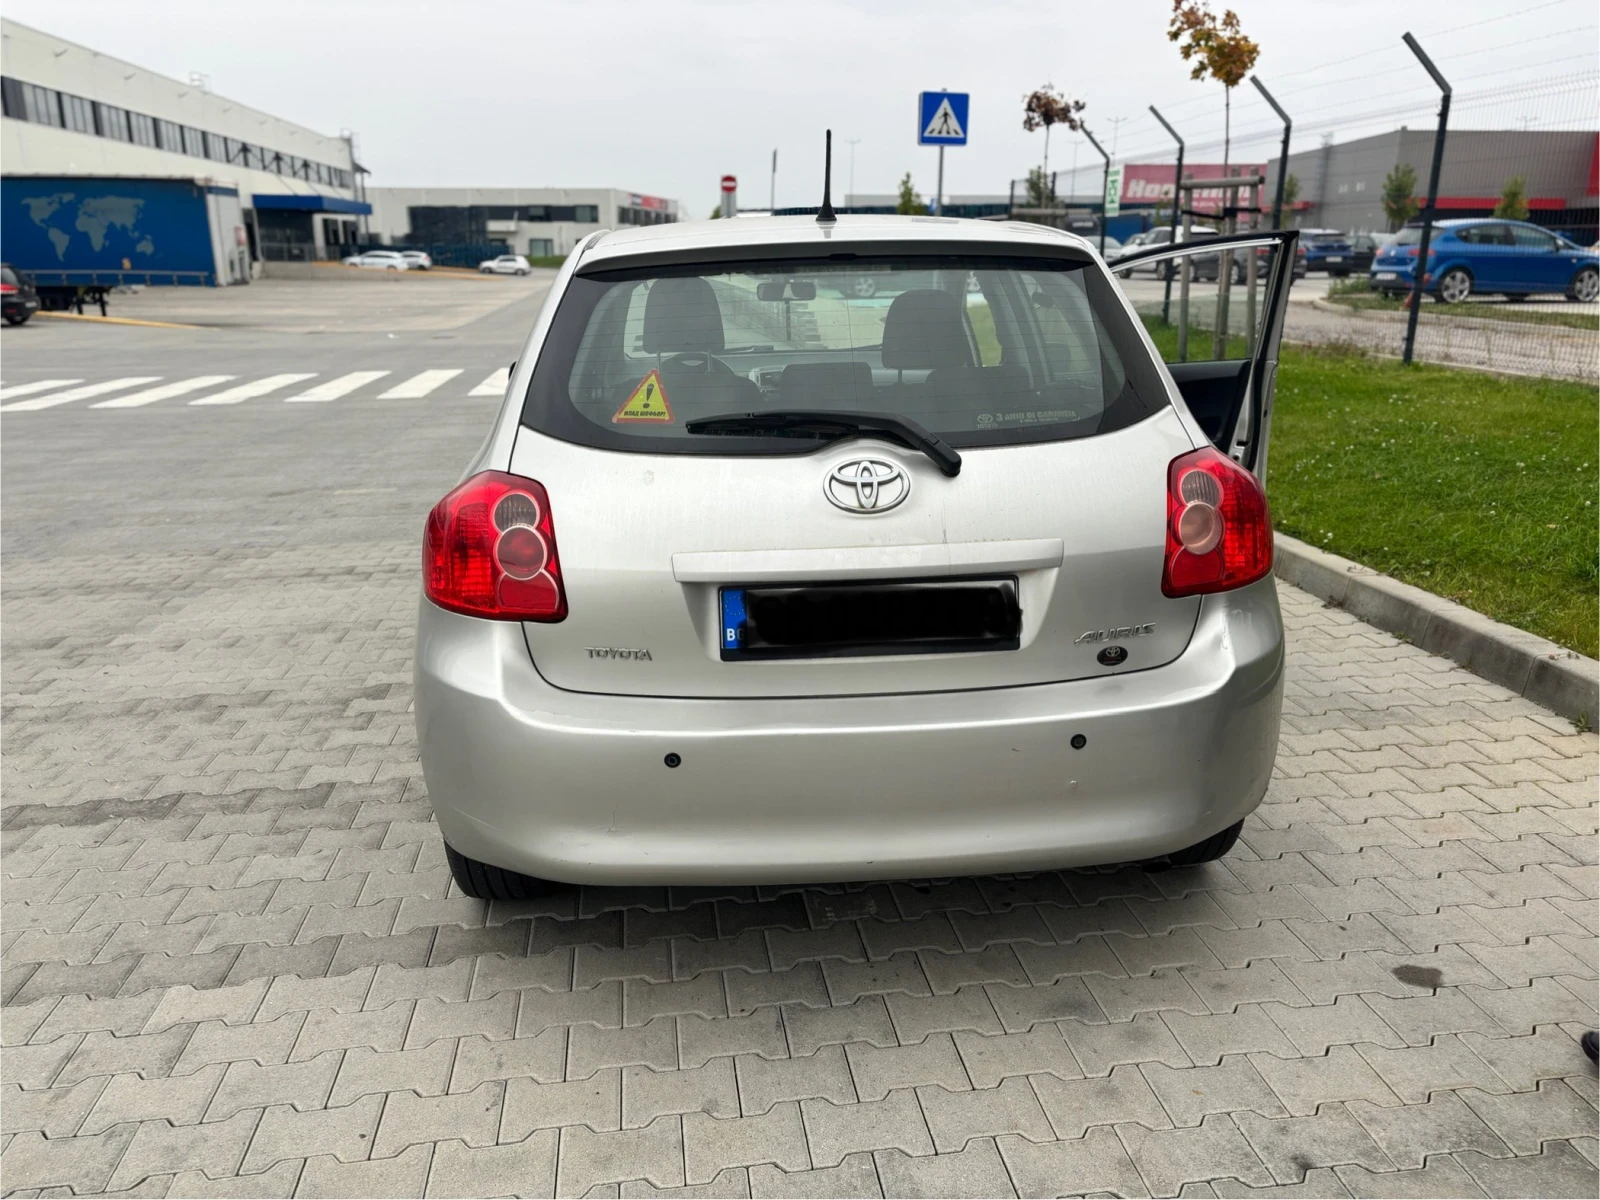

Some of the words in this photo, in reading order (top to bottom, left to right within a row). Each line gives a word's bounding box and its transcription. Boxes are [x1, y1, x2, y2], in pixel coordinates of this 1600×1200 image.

[996, 413, 1003, 422] 3
[1004, 412, 1025, 421] ANNI
[1026, 411, 1036, 419] DI
[1074, 622, 1156, 645] AURIS
[584, 646, 653, 661] TOYOTA
